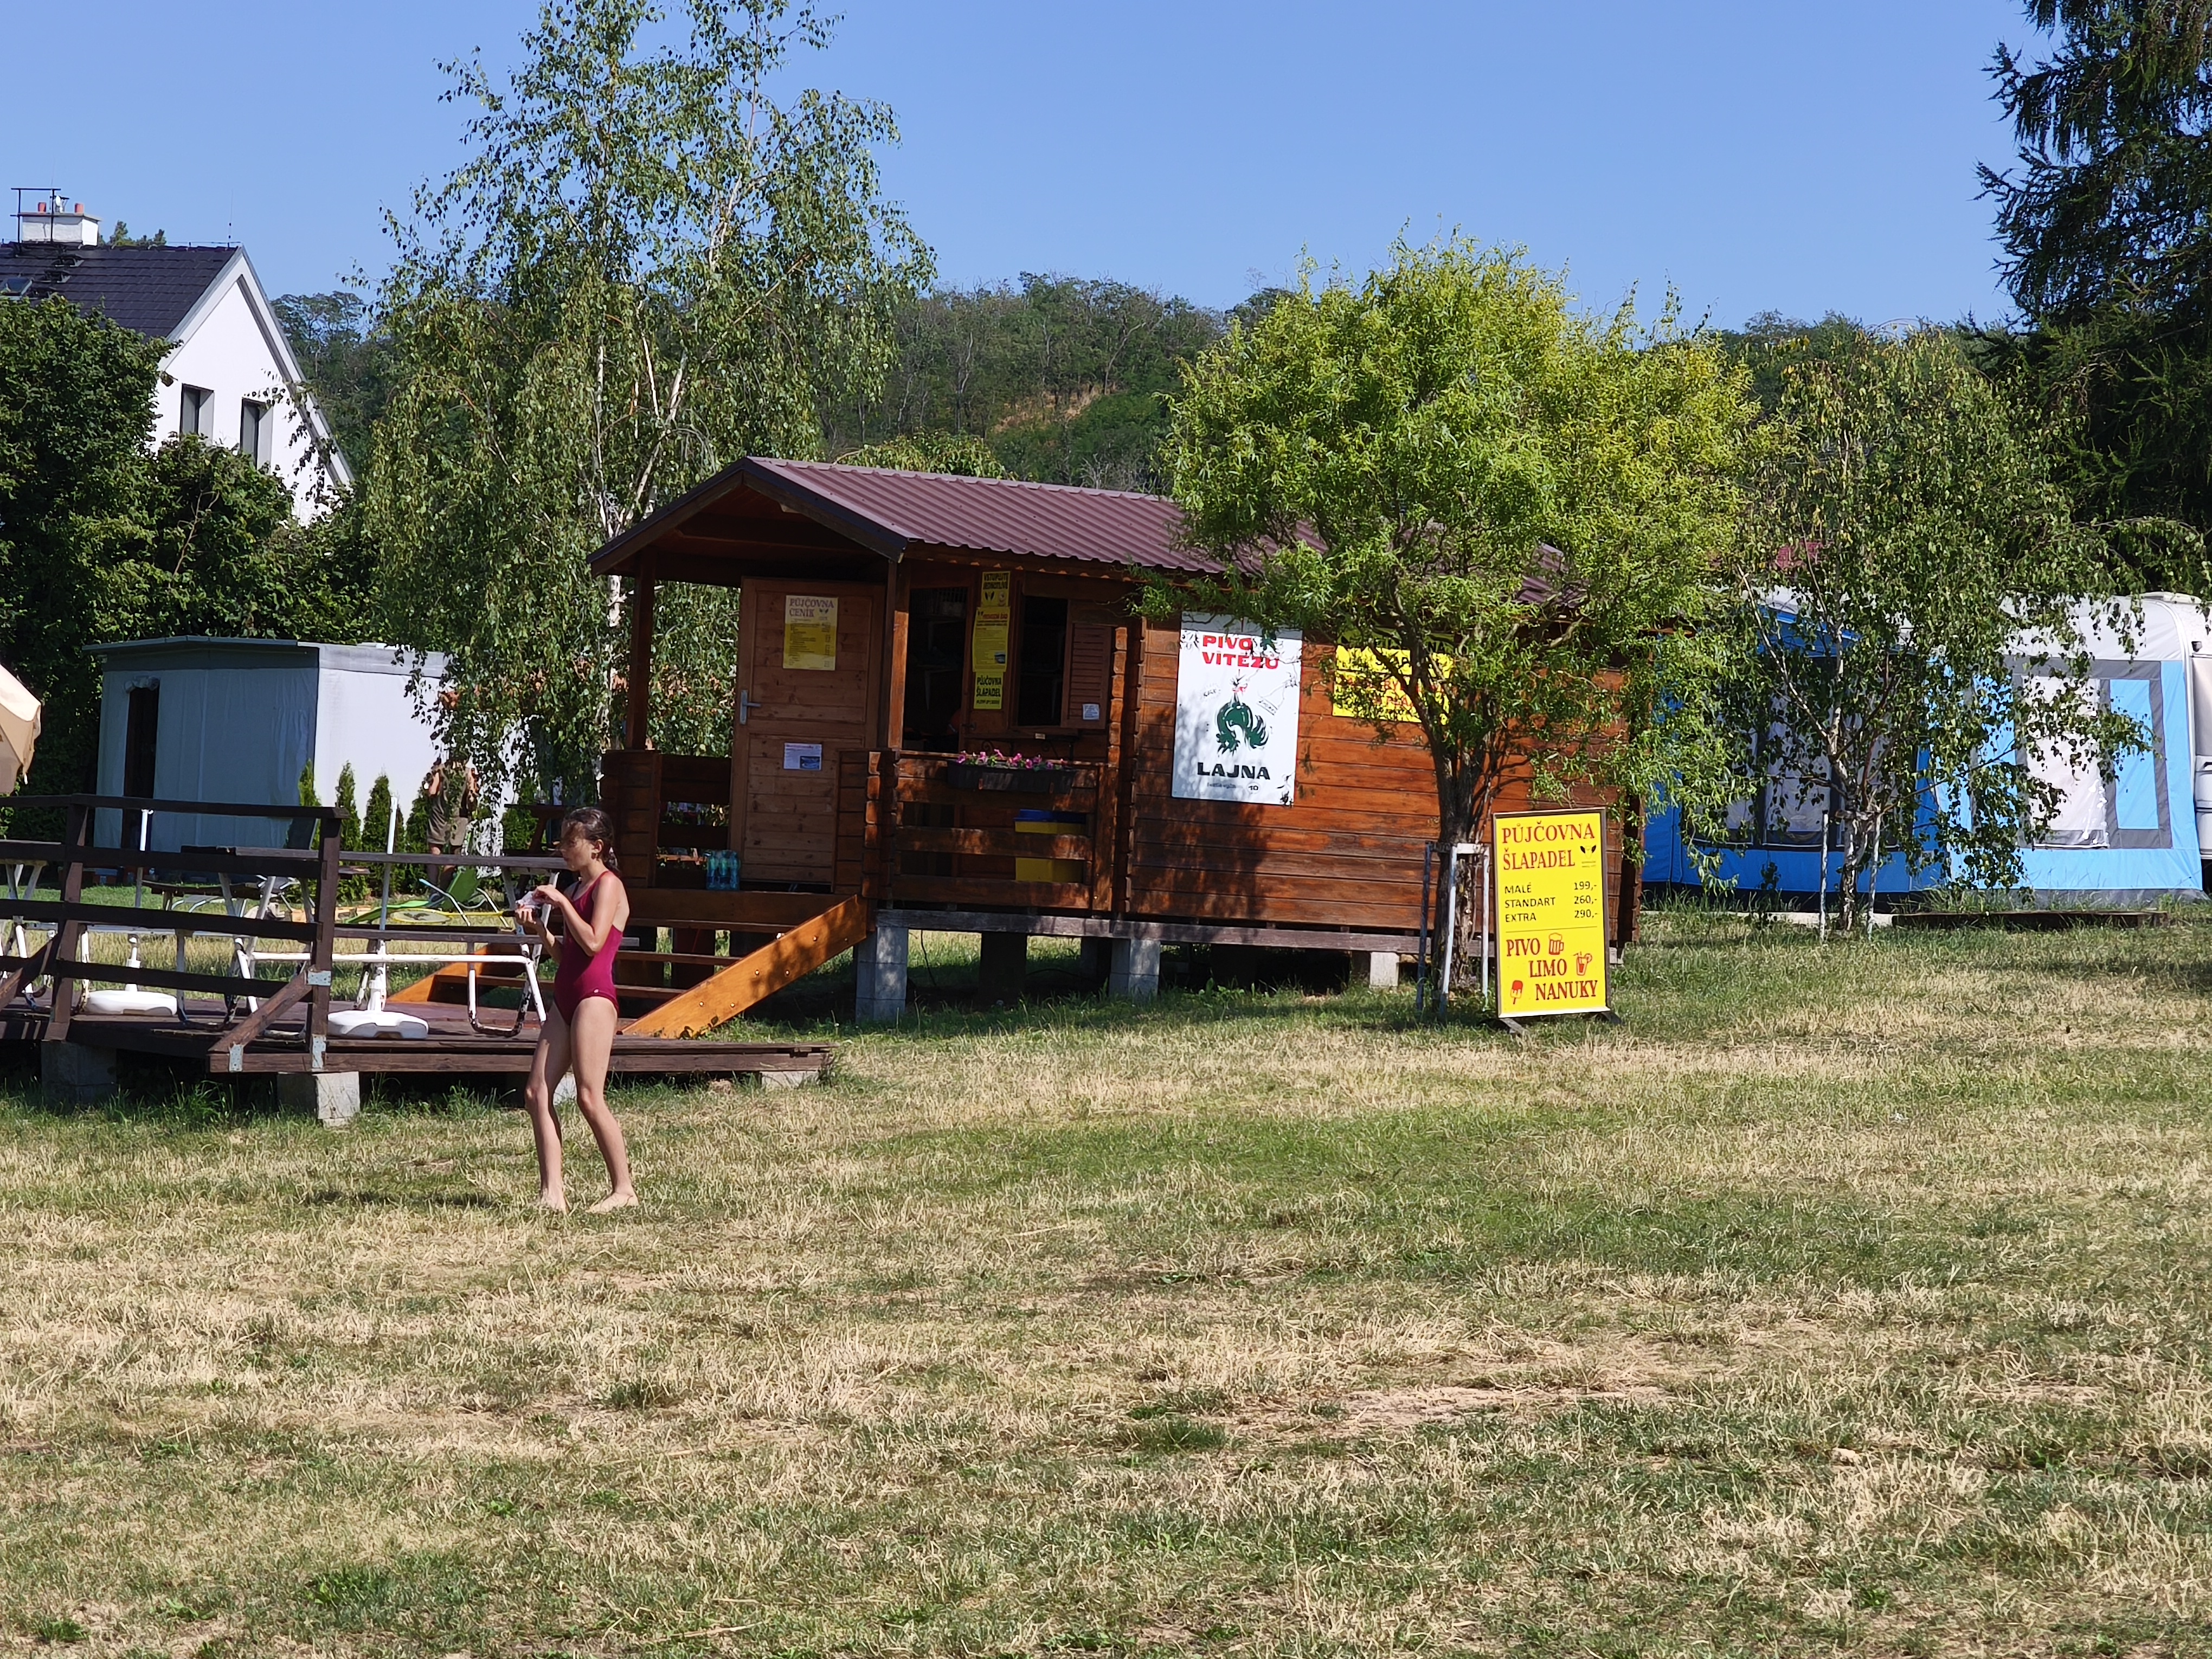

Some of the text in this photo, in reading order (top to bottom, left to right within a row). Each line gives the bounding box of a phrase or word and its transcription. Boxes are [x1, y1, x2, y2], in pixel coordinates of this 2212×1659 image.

[1203, 635, 1253, 651] PIVO
[1197, 762, 1270, 780] LAJNA
[1501, 820, 1595, 844] PŮJČOVNA
[1503, 847, 1576, 870] ŠLAPADEL
[1504, 881, 1597, 894] MALÉ 199,-
[1504, 895, 1597, 908] STANDART 260,-
[1505, 909, 1598, 923] EXTRA 290,-
[1506, 938, 1541, 957] PIVO
[1529, 959, 1567, 978] LIMO
[1535, 980, 1598, 1001] NANUKY
